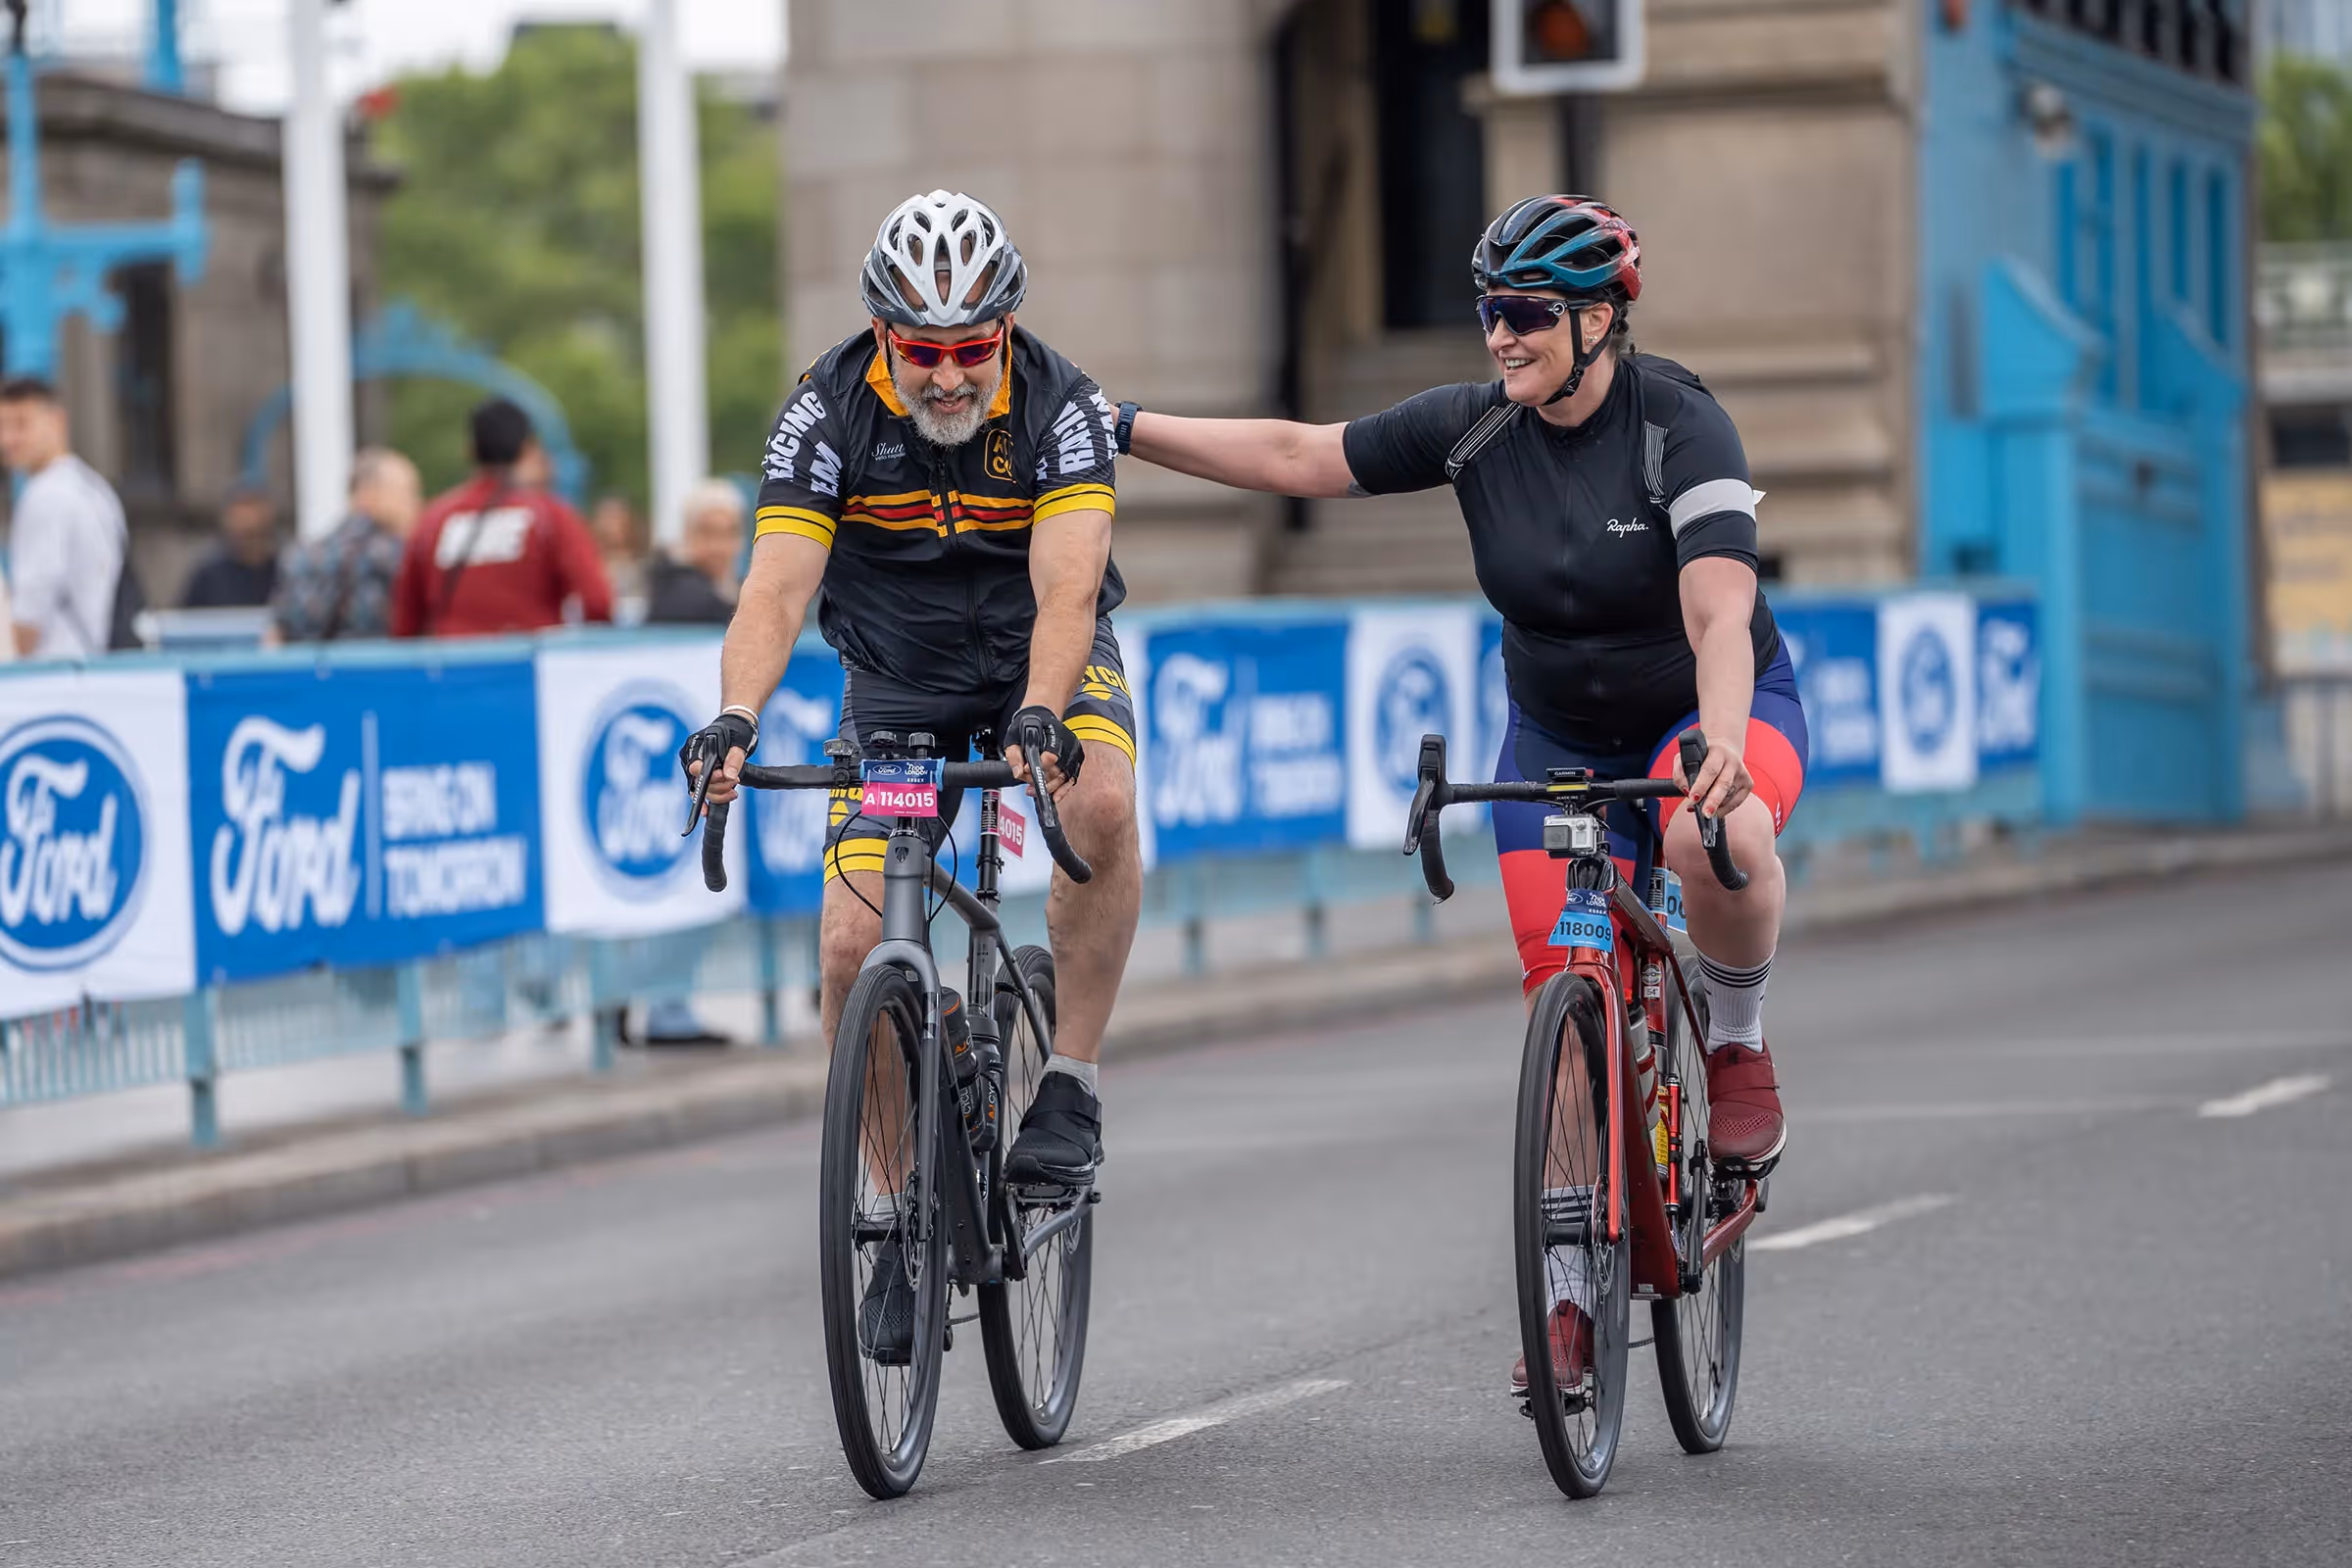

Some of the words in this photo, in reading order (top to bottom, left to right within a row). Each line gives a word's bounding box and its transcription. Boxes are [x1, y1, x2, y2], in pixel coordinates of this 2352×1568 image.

[0, 754, 118, 926] Ford
[212, 716, 360, 935] Ford
[864, 793, 875, 805] A
[881, 792, 934, 808] 114015
[1560, 921, 1612, 941] 118009
